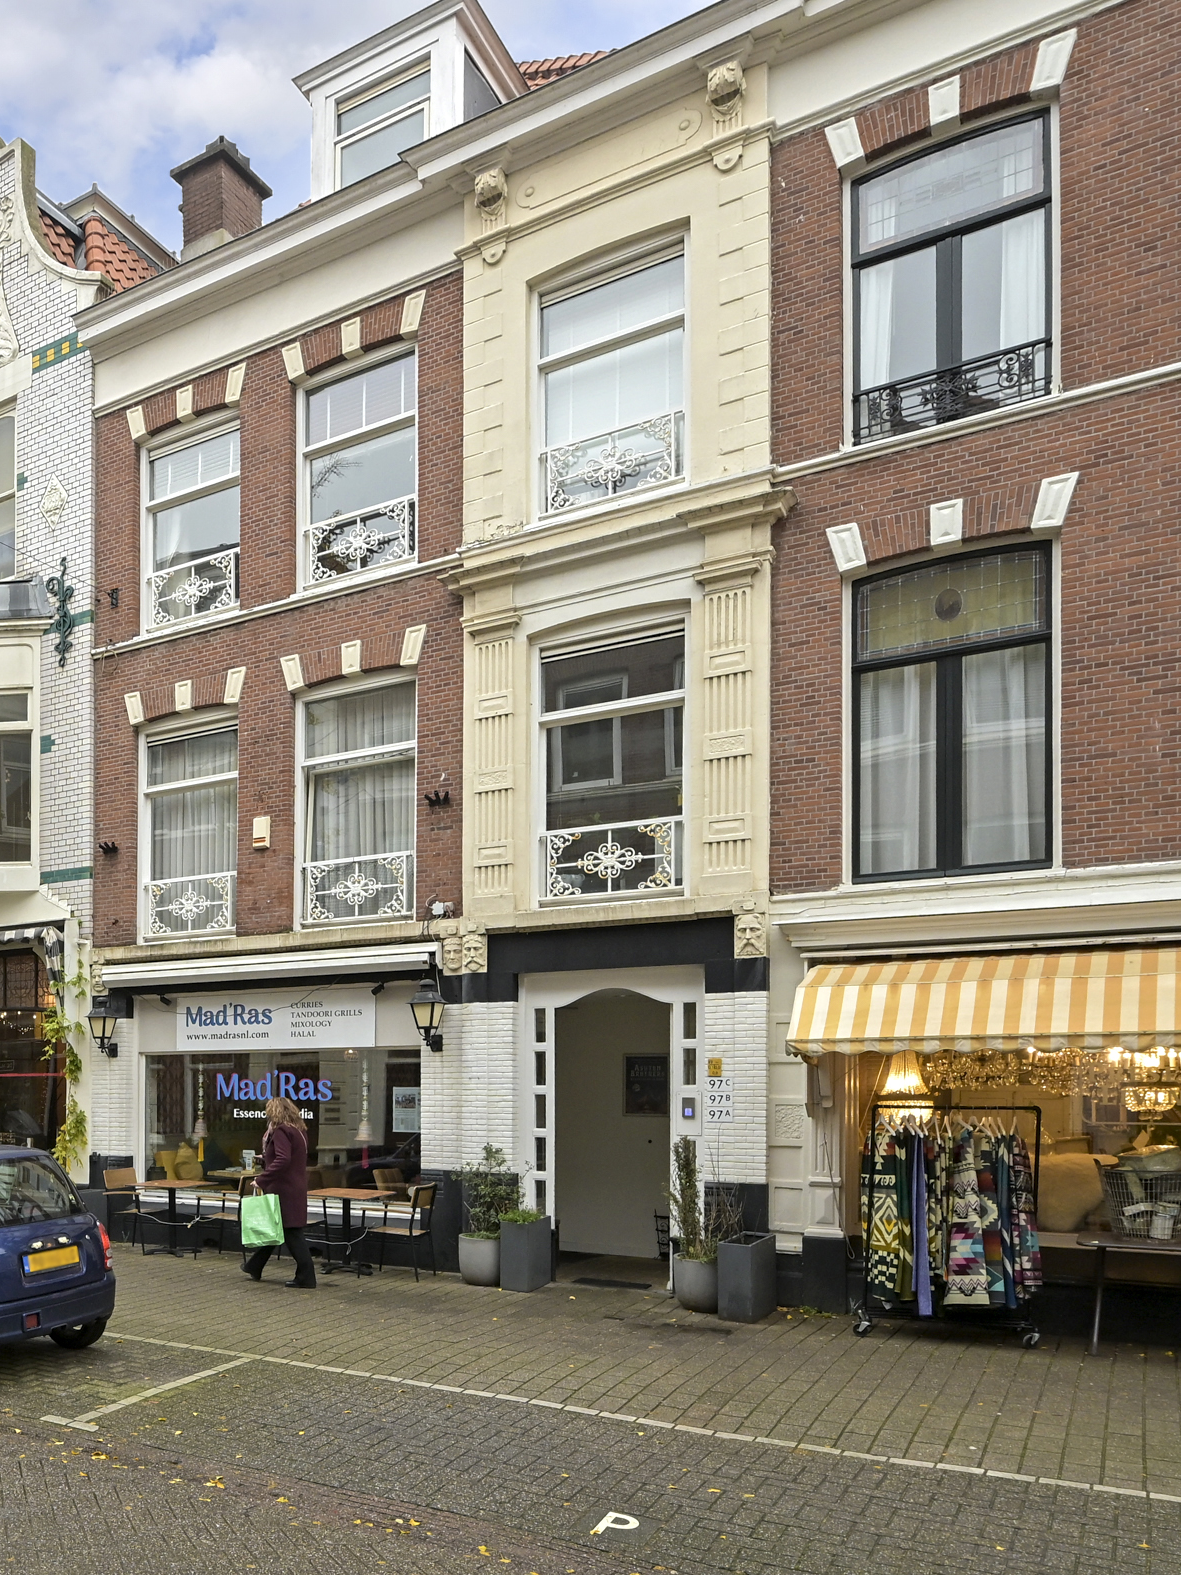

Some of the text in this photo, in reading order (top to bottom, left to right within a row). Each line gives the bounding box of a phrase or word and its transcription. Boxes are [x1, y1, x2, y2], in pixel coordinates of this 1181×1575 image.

[185, 1002, 273, 1027] Mad'Ras
[290, 1009, 363, 1019] TANDOORI GRILLS
[290, 1020, 333, 1028] MIXOLOGY
[186, 1029, 269, 1041] www.madrasnl.com
[290, 1030, 317, 1038] HALAL
[215, 1069, 333, 1101] Mad'Ras
[233, 1108, 267, 1118] Essenc
[591, 1511, 640, 1535] P
